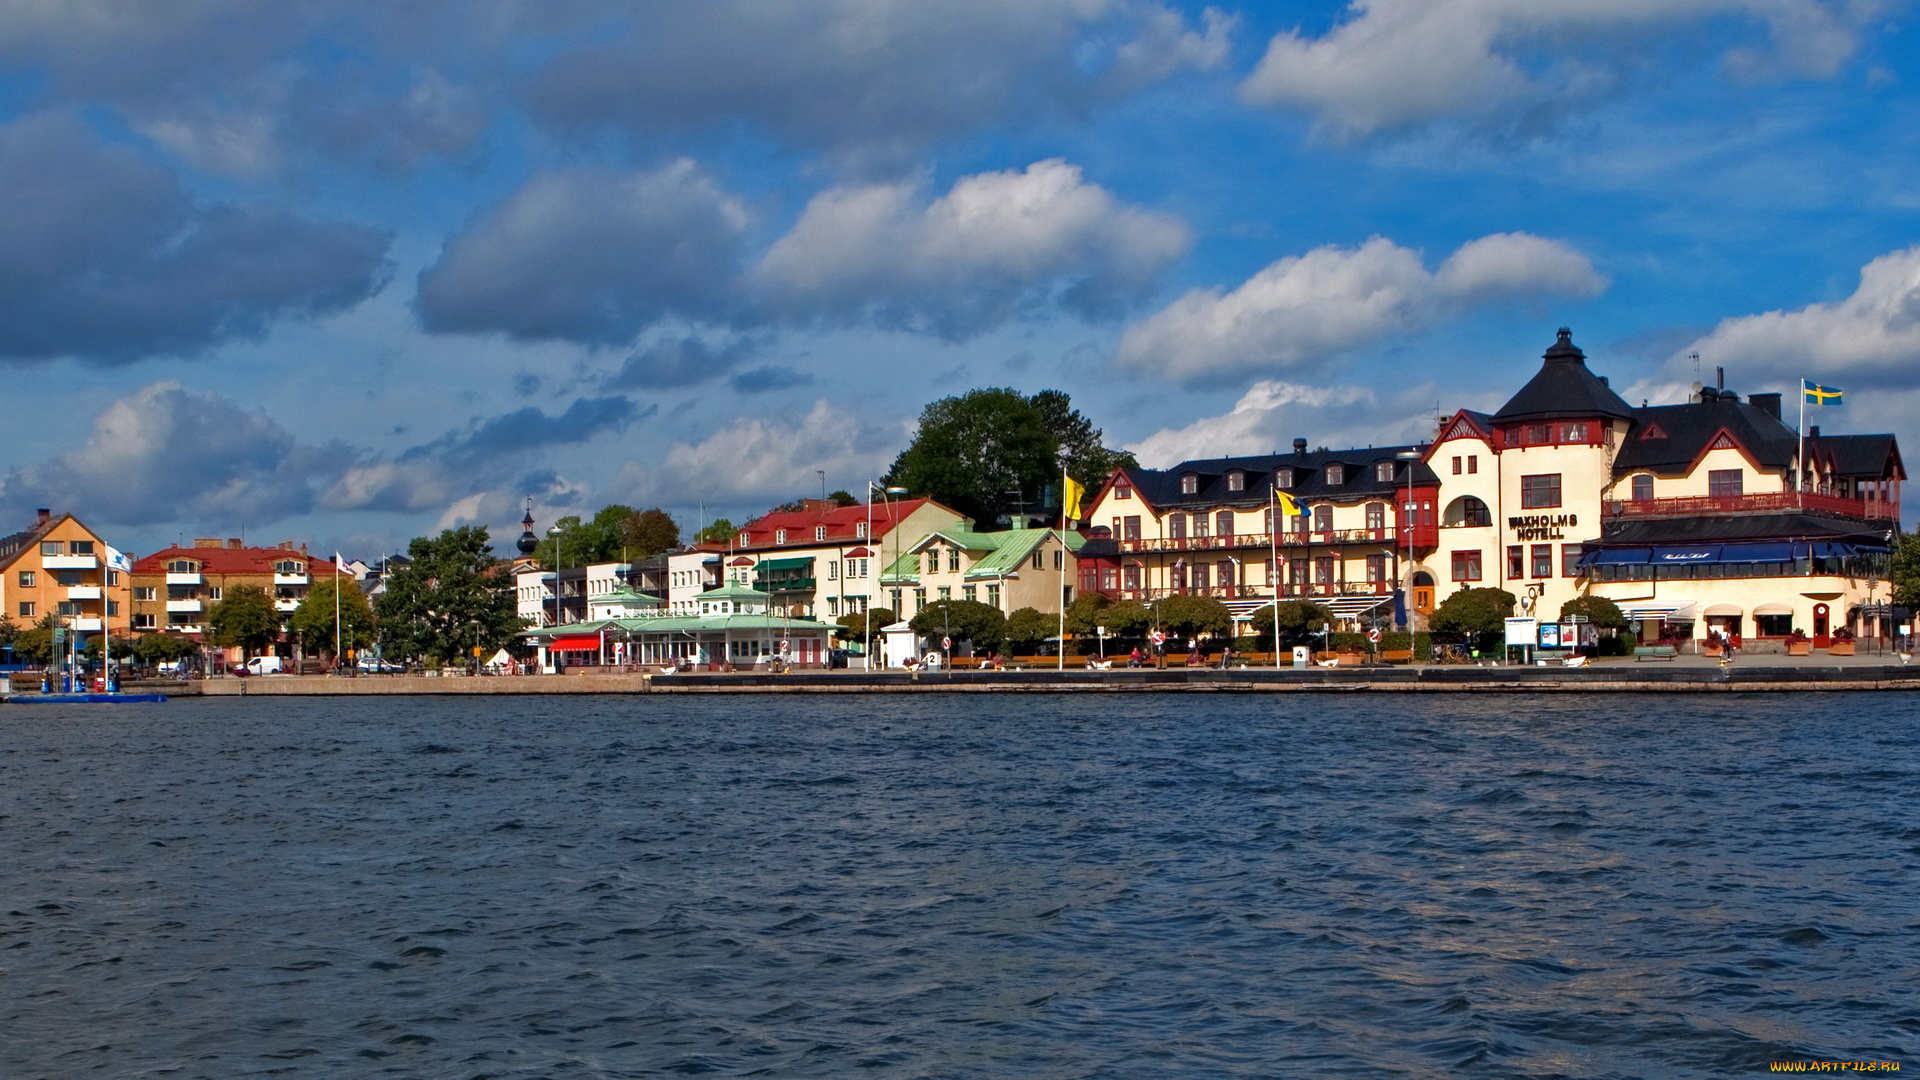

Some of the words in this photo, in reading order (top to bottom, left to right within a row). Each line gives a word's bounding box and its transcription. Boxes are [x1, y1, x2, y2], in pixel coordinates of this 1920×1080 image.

[1508, 514, 1577, 530] WAXHOLMS
[1517, 527, 1564, 542] HOTELL
[929, 654, 935, 663] 2
[1296, 650, 1303, 659] 4
